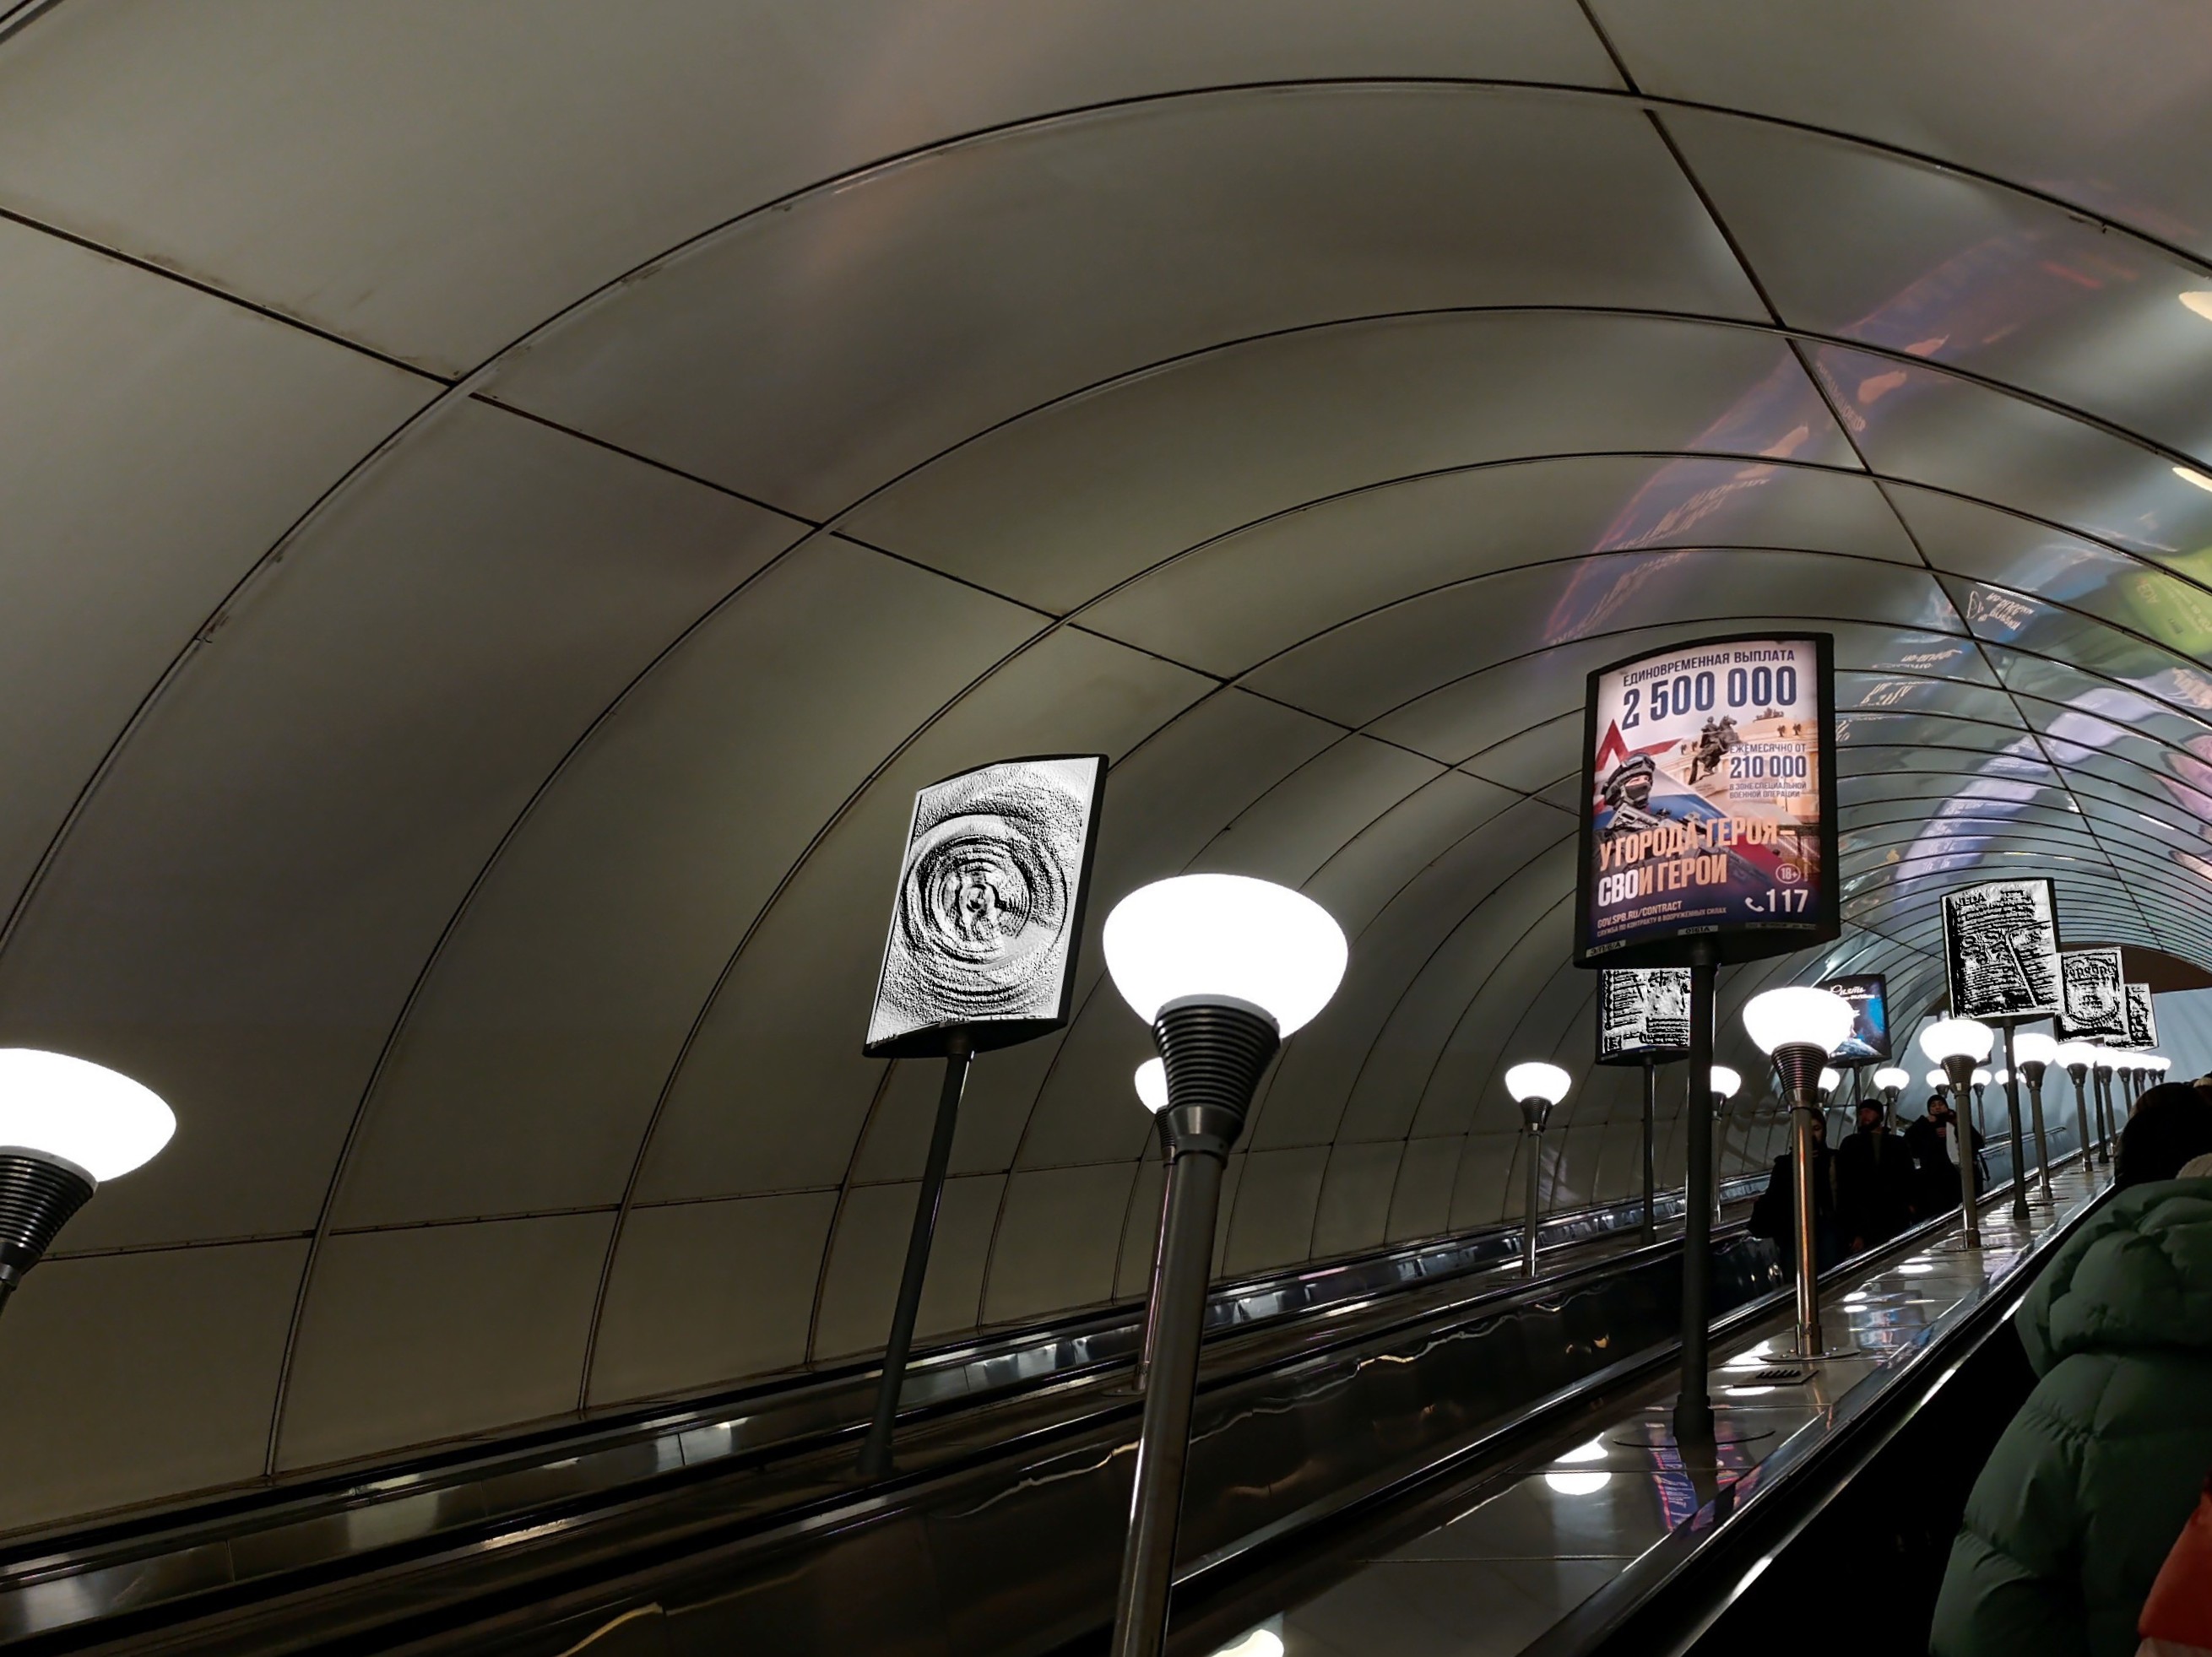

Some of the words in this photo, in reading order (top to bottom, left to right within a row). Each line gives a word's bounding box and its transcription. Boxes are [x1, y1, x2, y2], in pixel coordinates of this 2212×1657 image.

[1623, 653, 1730, 687] ЕДИНОВРЕМЕННАЯ
[1734, 649, 1795, 663] ВЫПЛАТА
[1621, 688, 1640, 730] 2
[1650, 670, 1716, 721] 500
[1727, 665, 1797, 707] 000
[1729, 743, 1792, 754] ЕЖЕМЕСЯЧНО
[1795, 744, 1807, 753] ОТ
[1730, 755, 1764, 779] 210
[1770, 755, 1807, 778] 000
[1599, 842, 1613, 872] У
[1614, 824, 1698, 868] ГОРОДА
[1705, 816, 1779, 850] ГЕРОЯ
[1597, 865, 1653, 907] СВОИ
[1656, 853, 1727, 892] ГЕРОИ
[1781, 867, 1797, 880] 18+
[1597, 900, 1683, 929] GOV.SPB.RU/CONTRACT
[1766, 888, 1808, 912] 117
